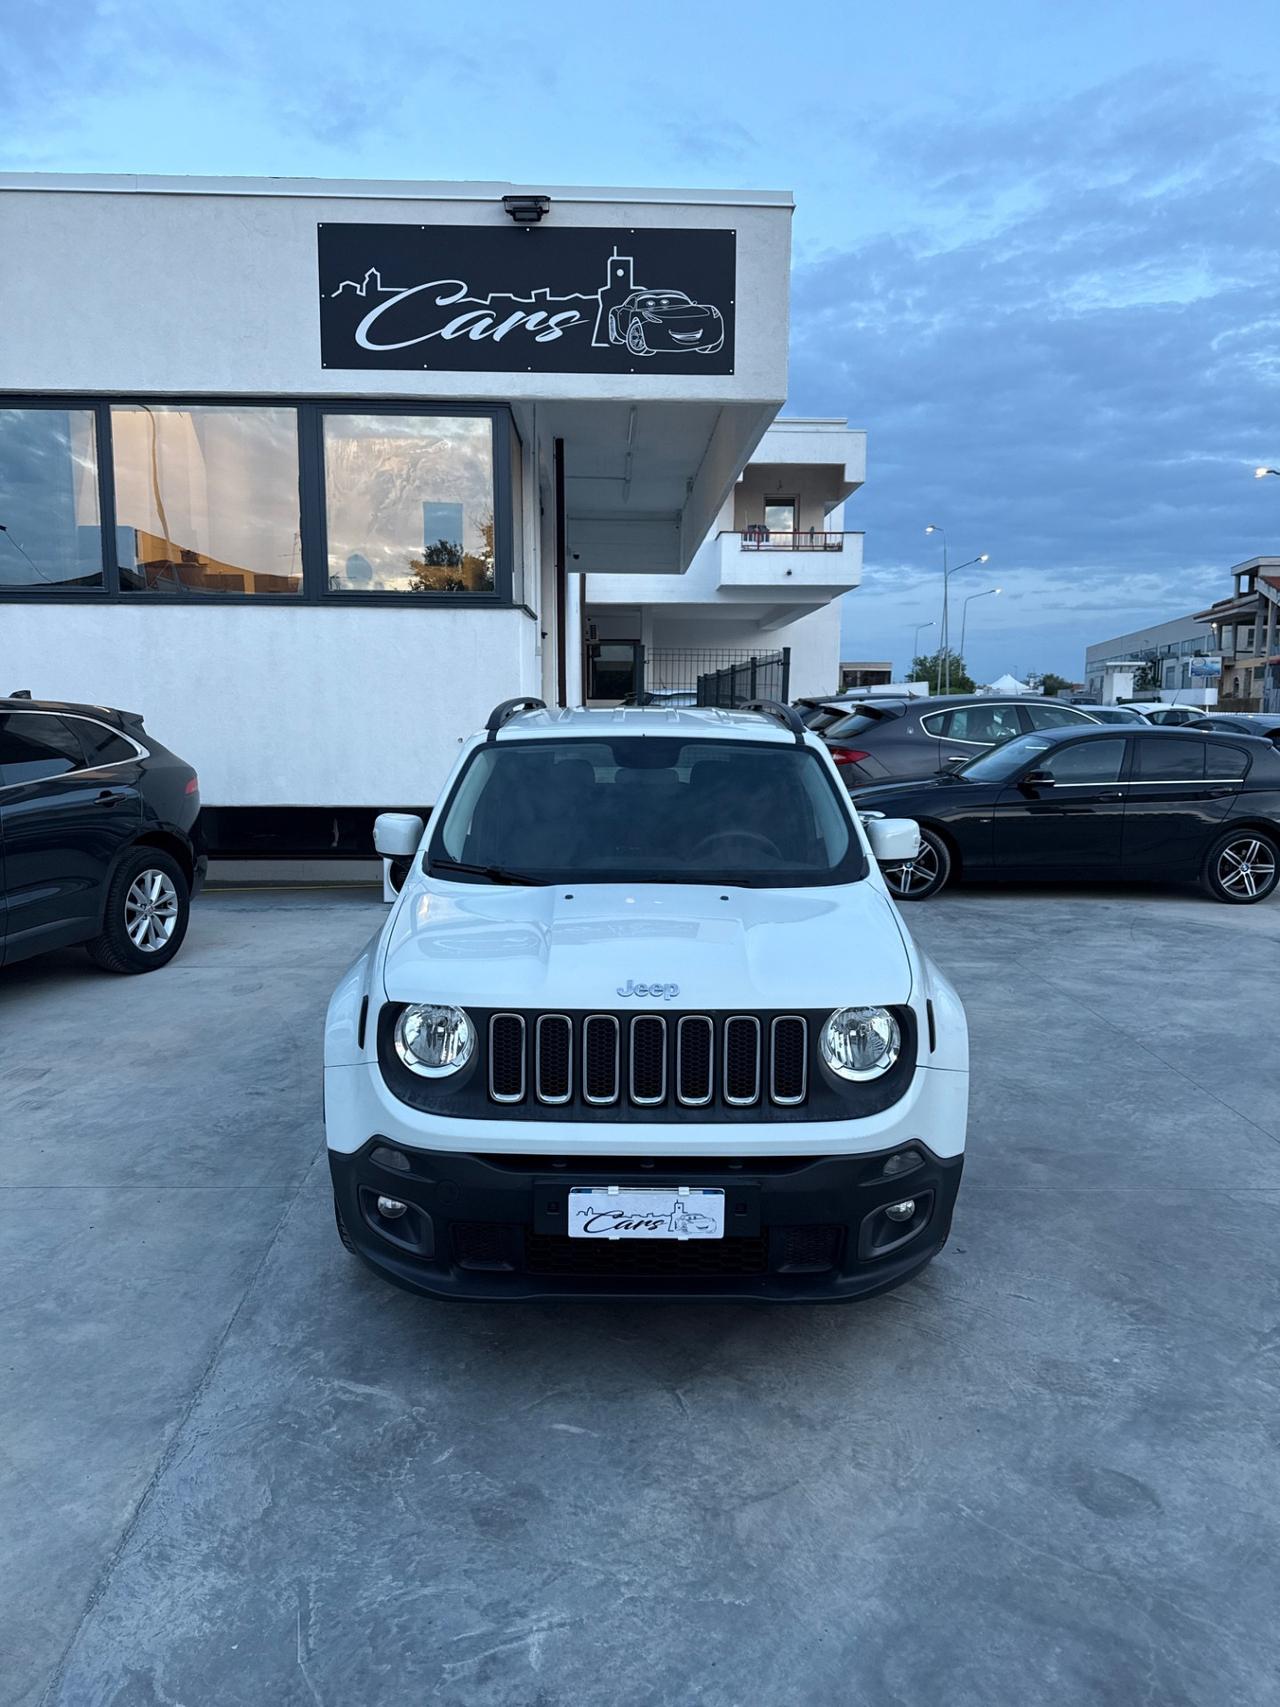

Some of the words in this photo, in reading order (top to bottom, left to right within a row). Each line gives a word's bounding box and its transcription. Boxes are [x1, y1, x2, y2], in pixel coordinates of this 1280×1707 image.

[355, 279, 590, 351] Cars
[617, 980, 680, 1001] Jeep
[583, 1210, 666, 1233] Cars
